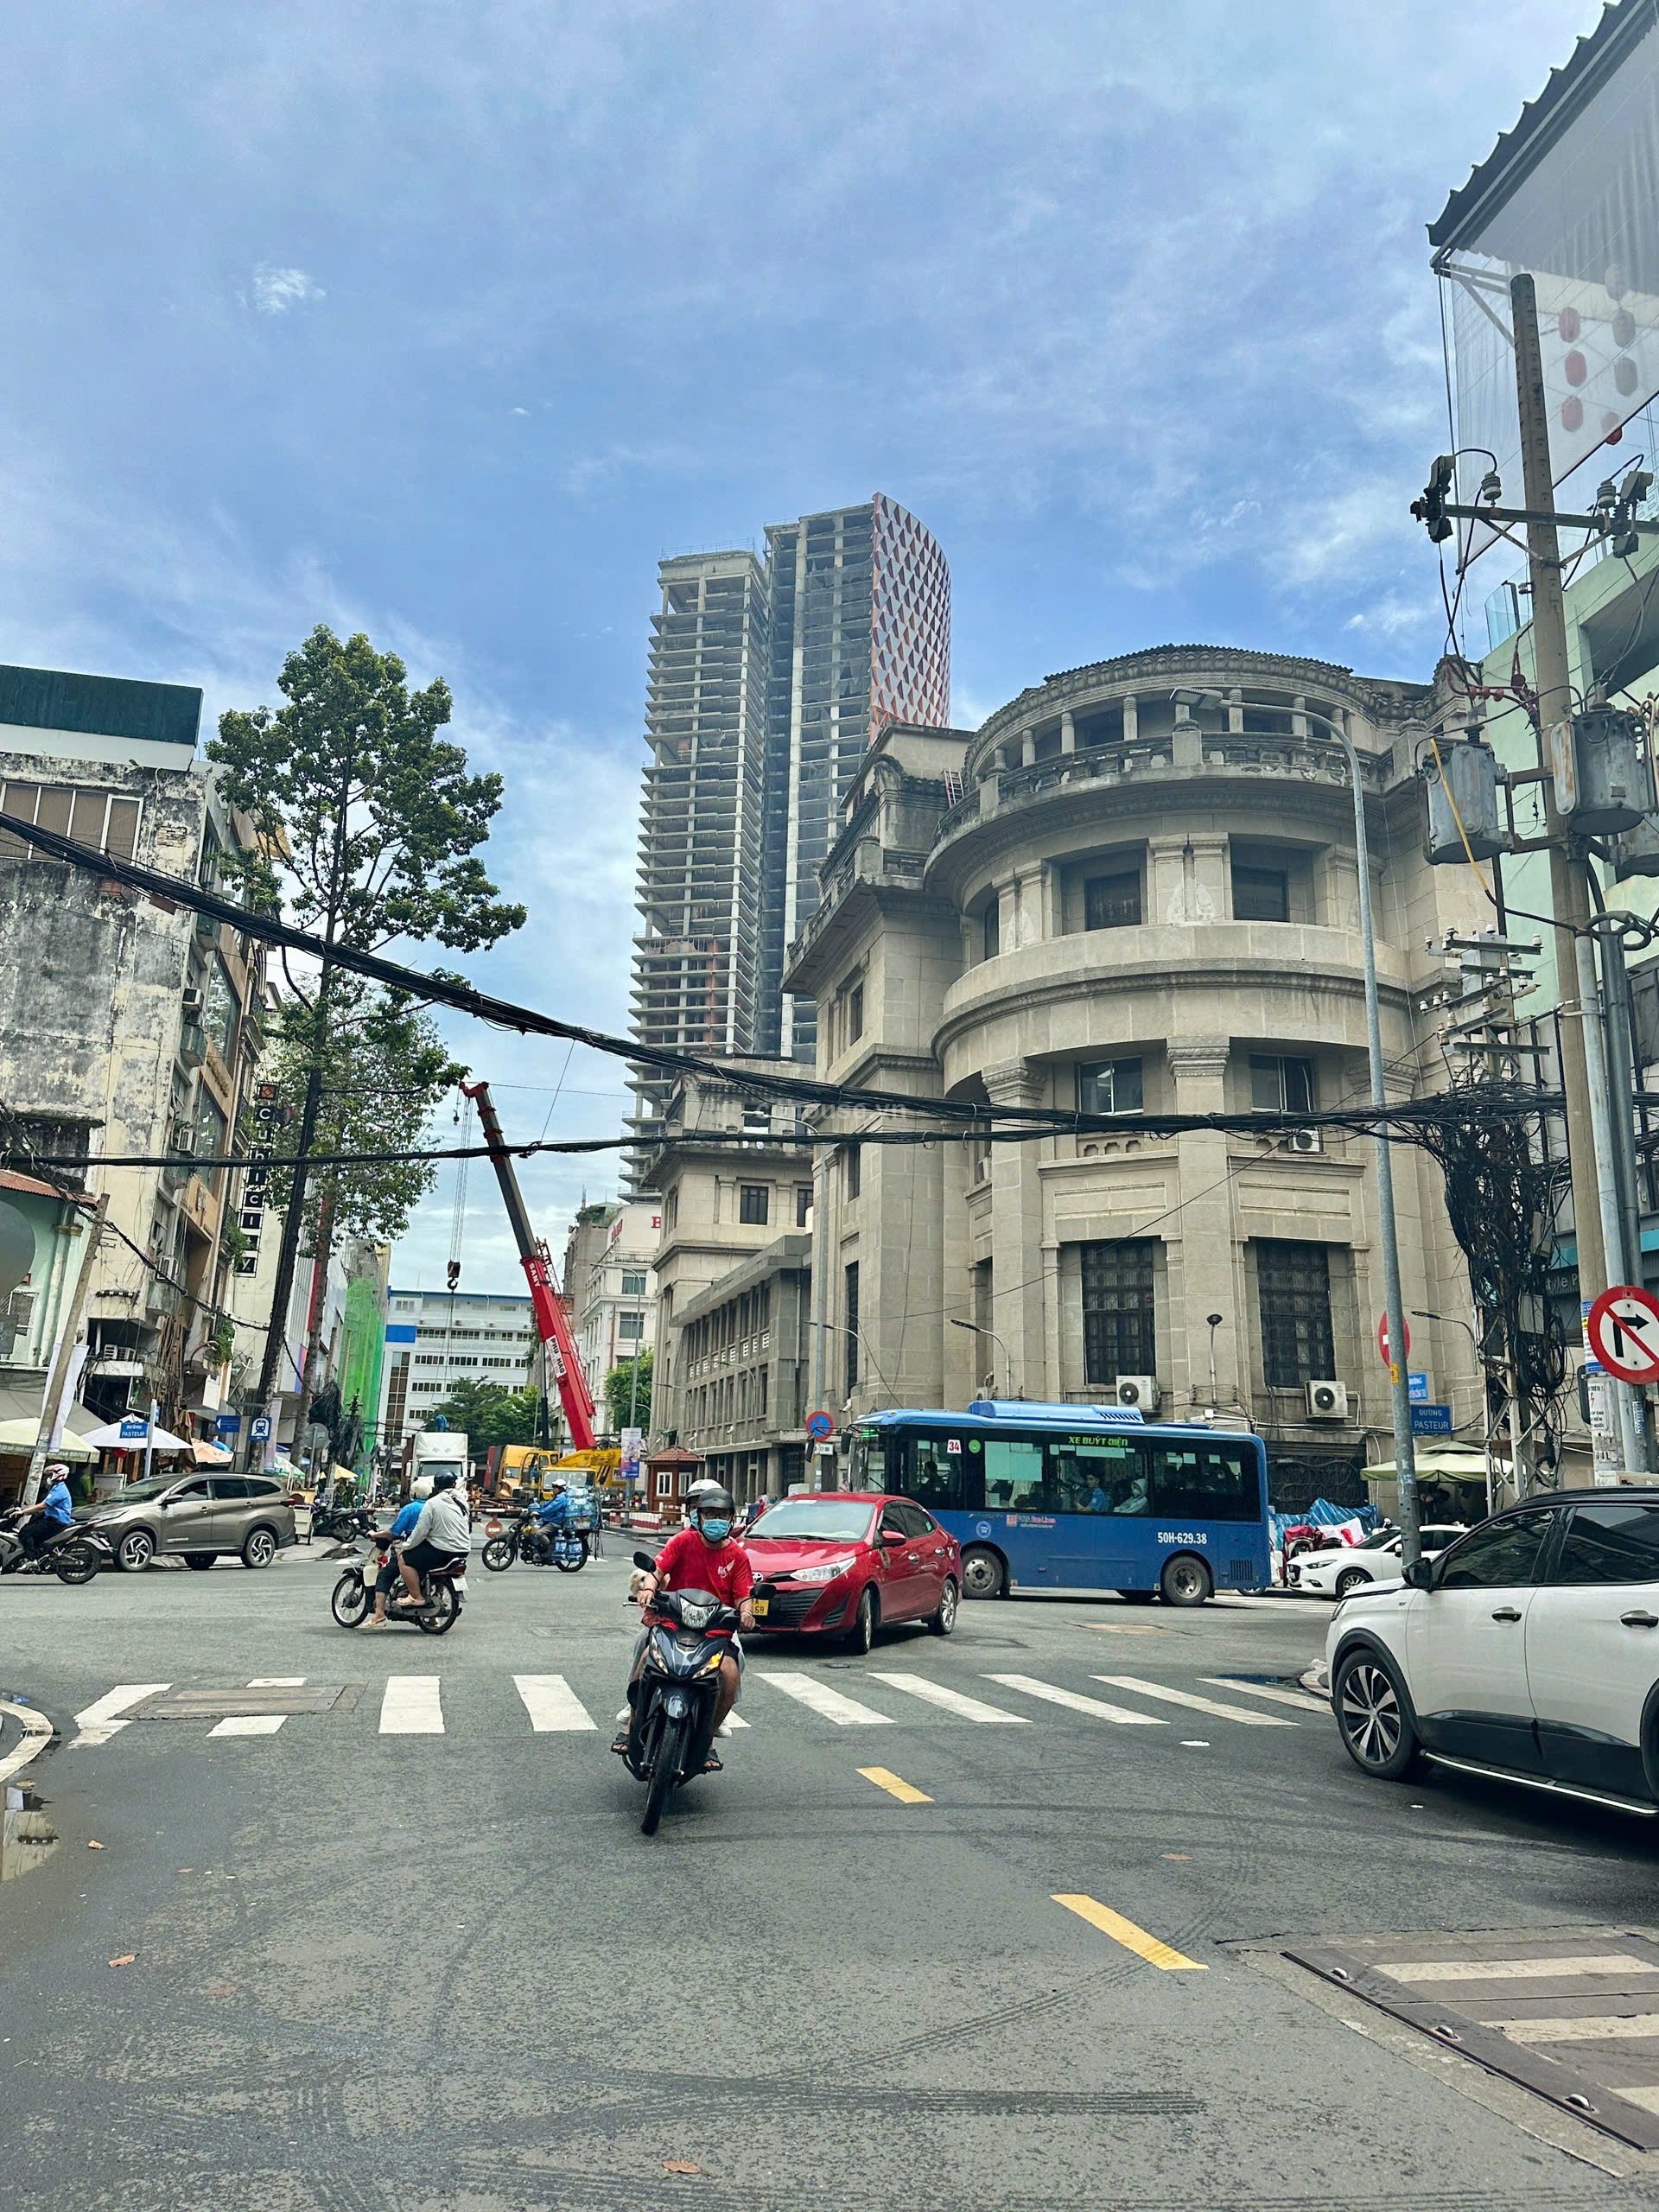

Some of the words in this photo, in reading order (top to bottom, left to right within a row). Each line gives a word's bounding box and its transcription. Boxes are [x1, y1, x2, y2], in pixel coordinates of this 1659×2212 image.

[529, 1262, 540, 1287] SANY
[1414, 1421, 1449, 1430] PASTEUR
[948, 1440, 960, 1452] 34
[1157, 1531, 1207, 1545] 50H-629.38
